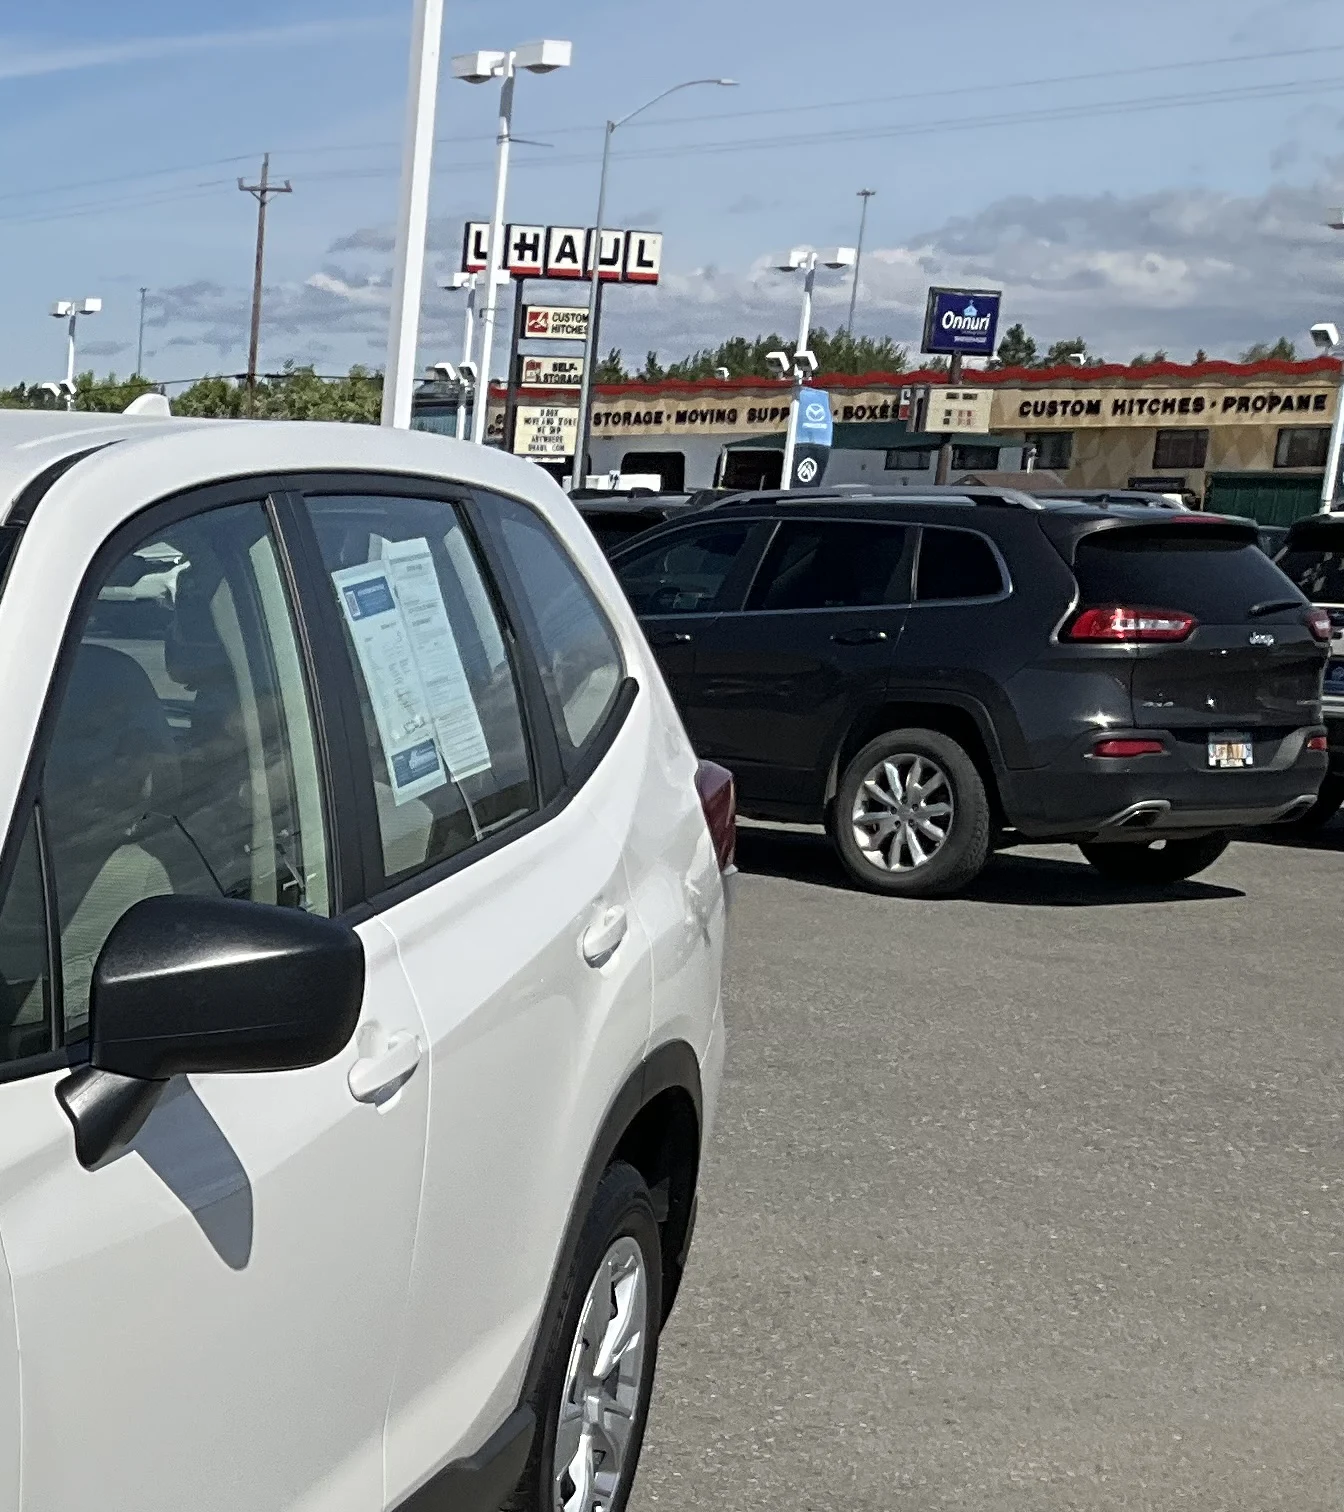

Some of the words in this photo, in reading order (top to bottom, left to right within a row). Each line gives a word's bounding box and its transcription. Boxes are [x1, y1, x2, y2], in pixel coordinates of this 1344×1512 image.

[942, 311, 991, 331] Onnuri
[1018, 399, 1102, 418] CUSTOM
[1112, 396, 1205, 416] HITCHES
[1221, 393, 1329, 413] PROPANE
[593, 410, 665, 427] STORAGE
[675, 408, 738, 425] MOVING
